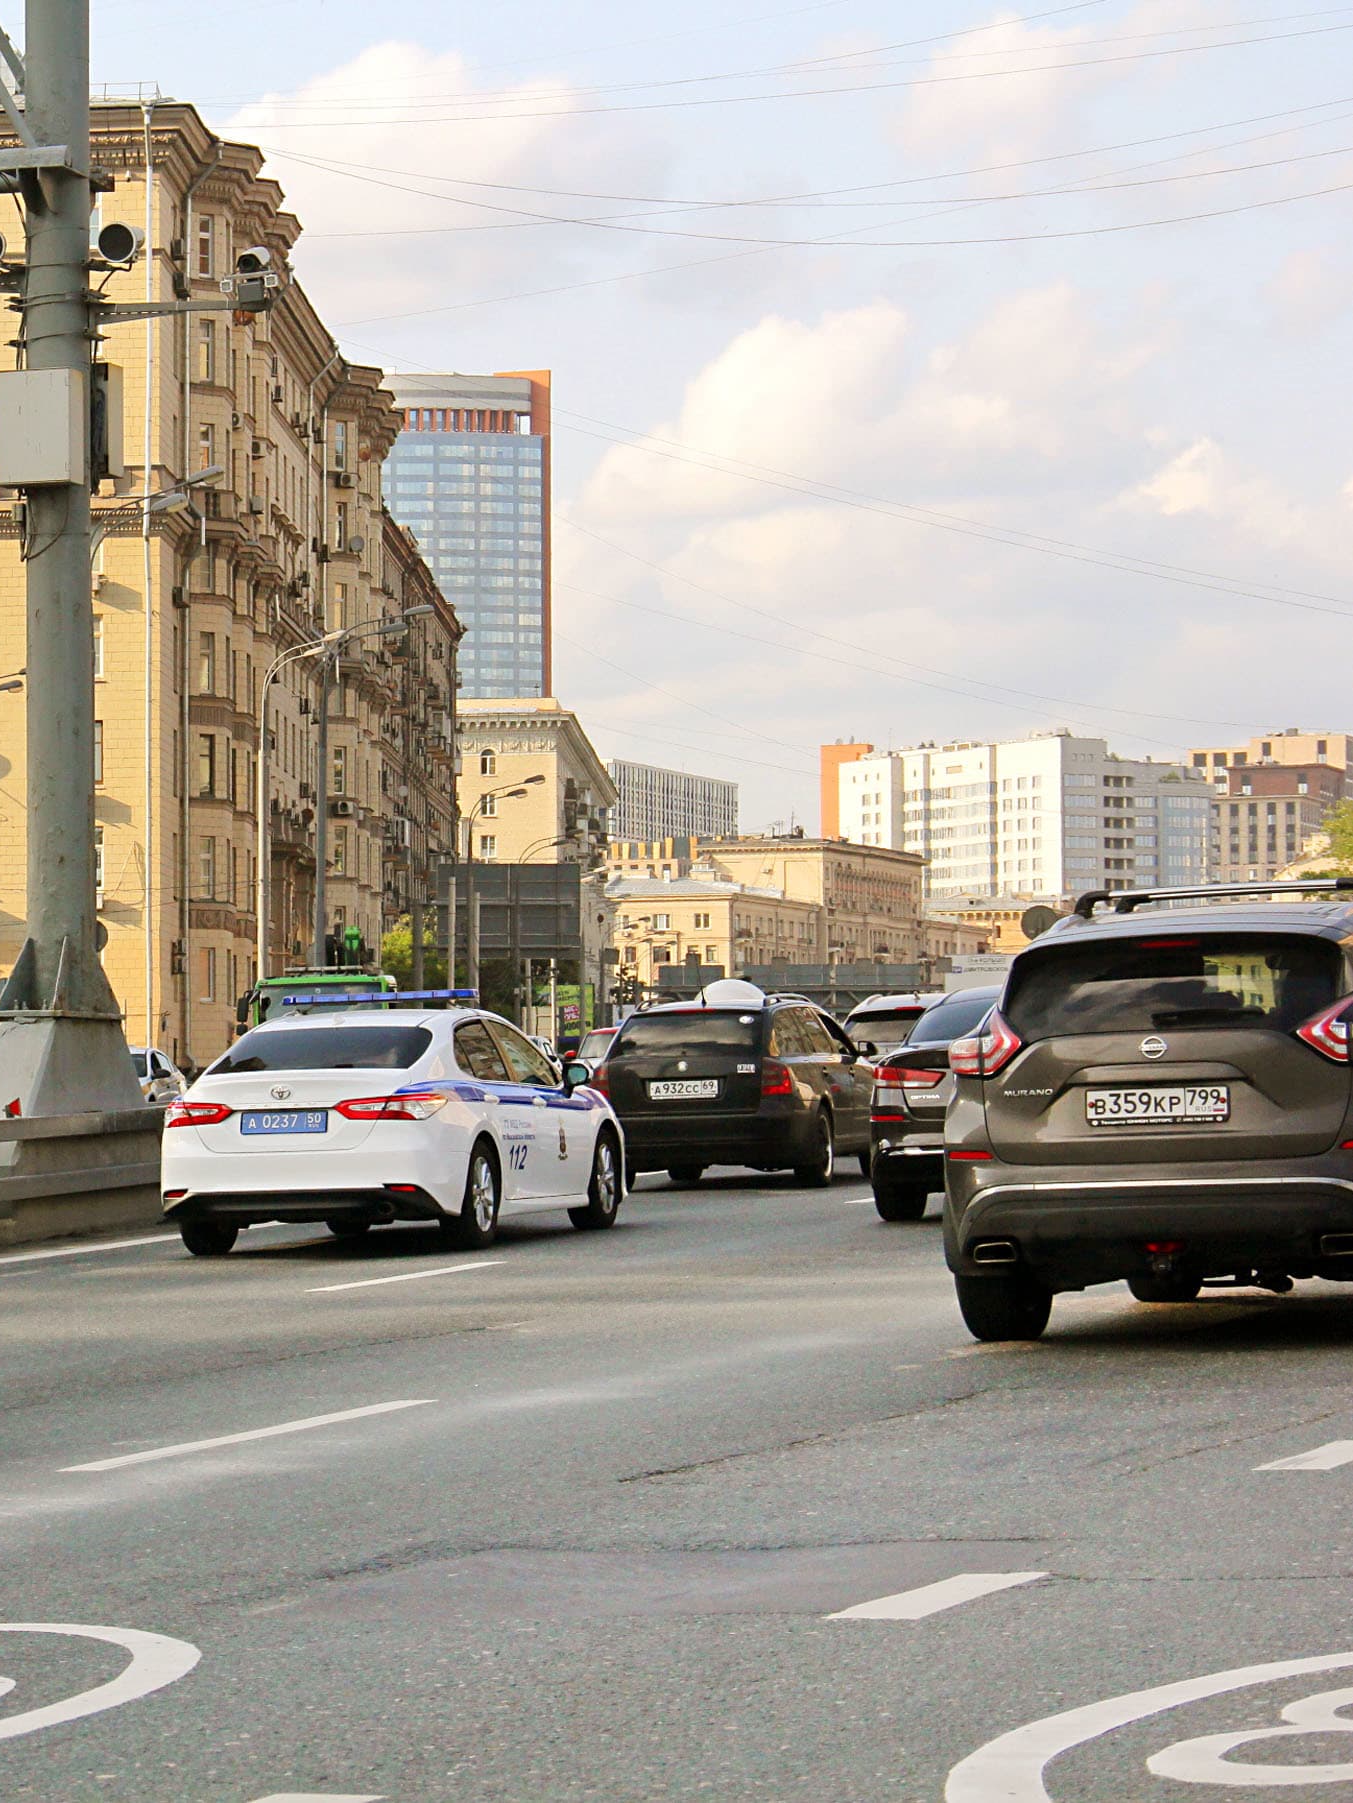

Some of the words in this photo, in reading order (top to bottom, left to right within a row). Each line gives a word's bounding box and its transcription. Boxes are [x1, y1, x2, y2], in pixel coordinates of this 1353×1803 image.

[654, 1082, 699, 1095] А932СС
[702, 1081, 714, 1090] 69
[1003, 1088, 1053, 1097] MURANO
[1094, 1091, 1181, 1115] В359КР
[1186, 1089, 1221, 1106] 799
[248, 1118, 257, 1129] А
[262, 1114, 298, 1129] 0237
[307, 1113, 322, 1124] 50
[509, 1144, 528, 1170] 112
